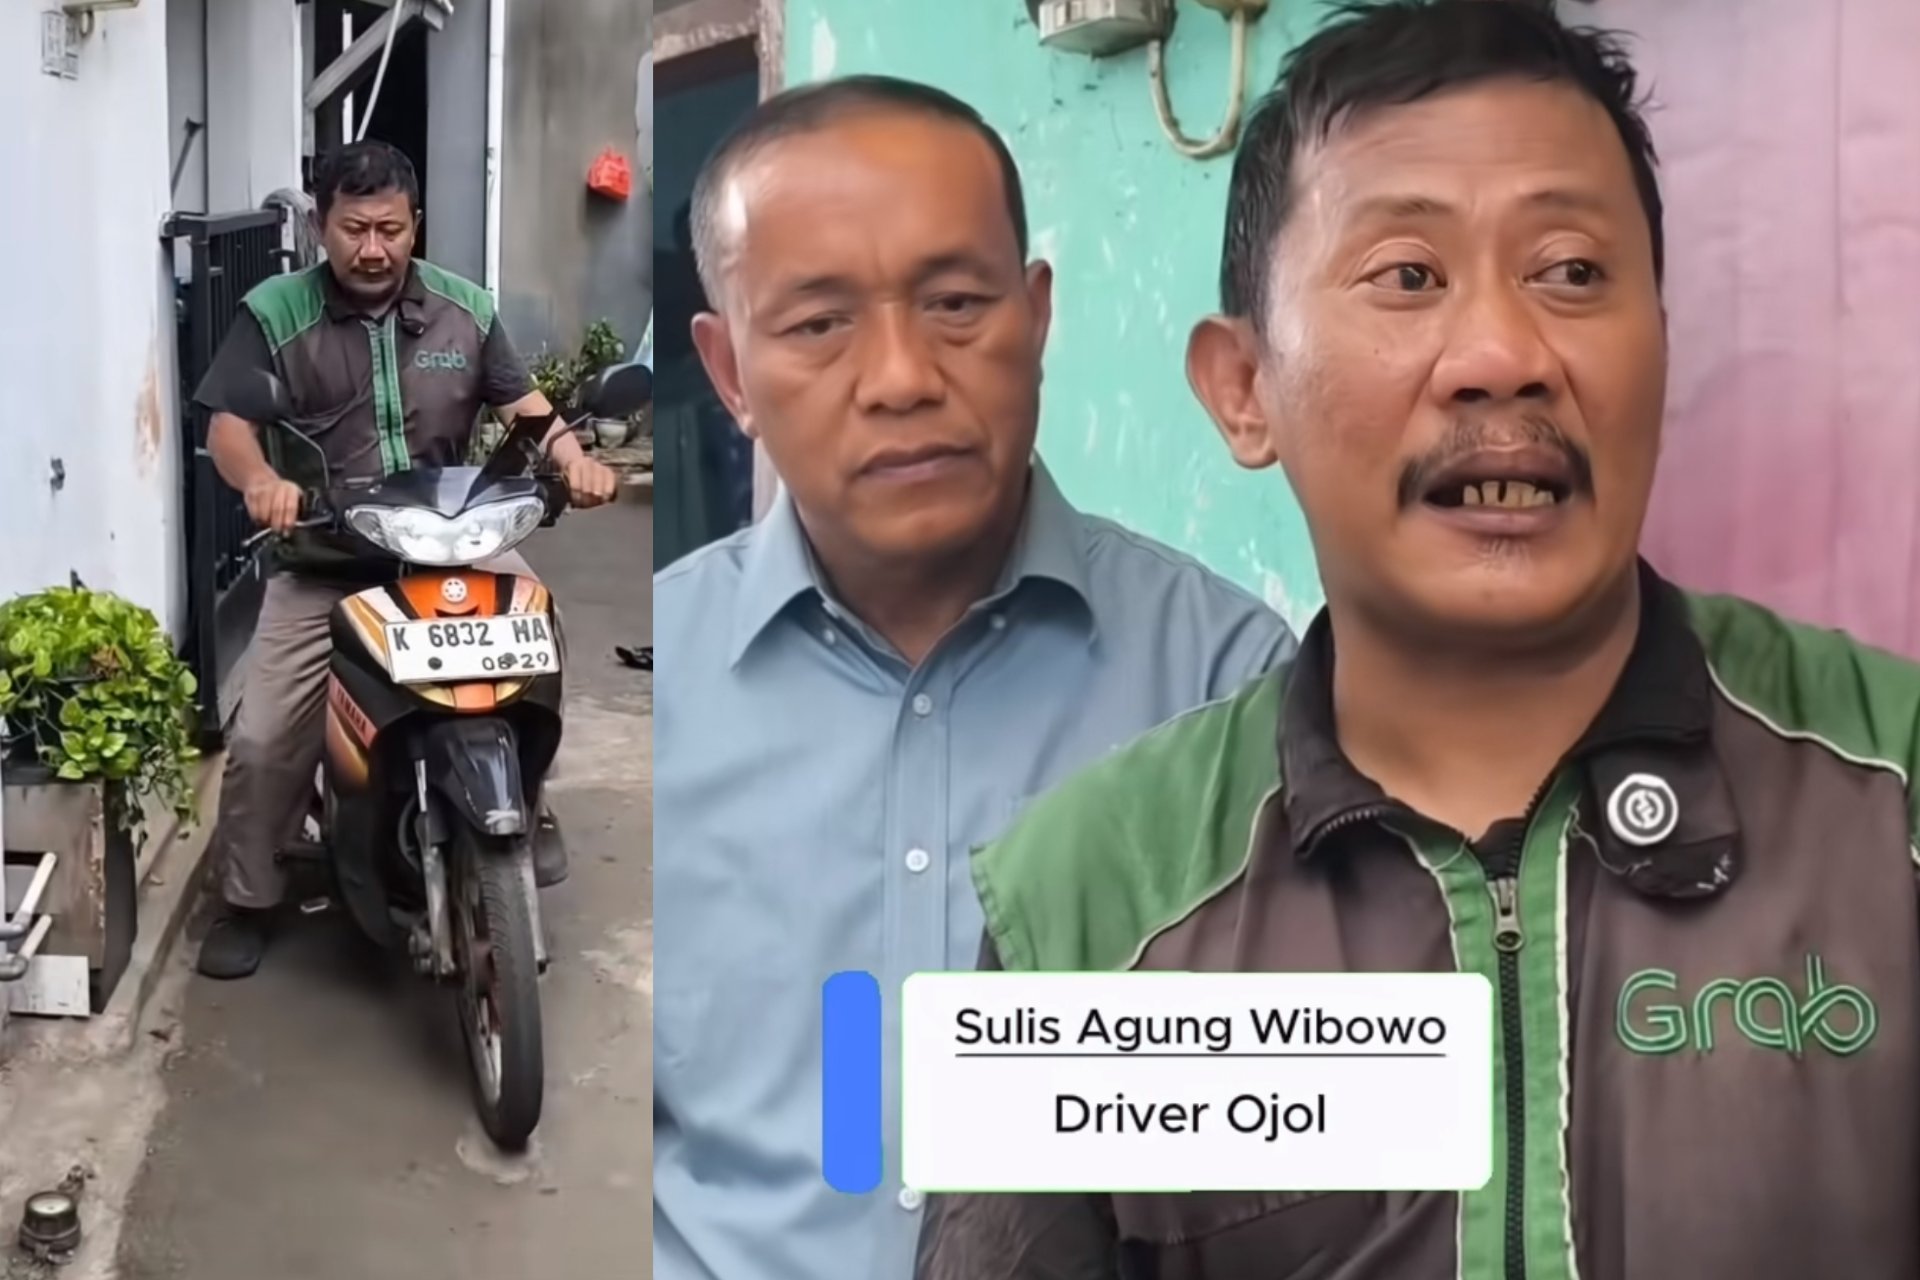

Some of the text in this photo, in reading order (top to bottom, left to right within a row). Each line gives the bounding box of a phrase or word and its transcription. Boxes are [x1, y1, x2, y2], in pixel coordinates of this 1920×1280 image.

[414, 348, 467, 369] Grab
[392, 617, 548, 651] K 6832 MA
[1616, 952, 1877, 1060] Grab
